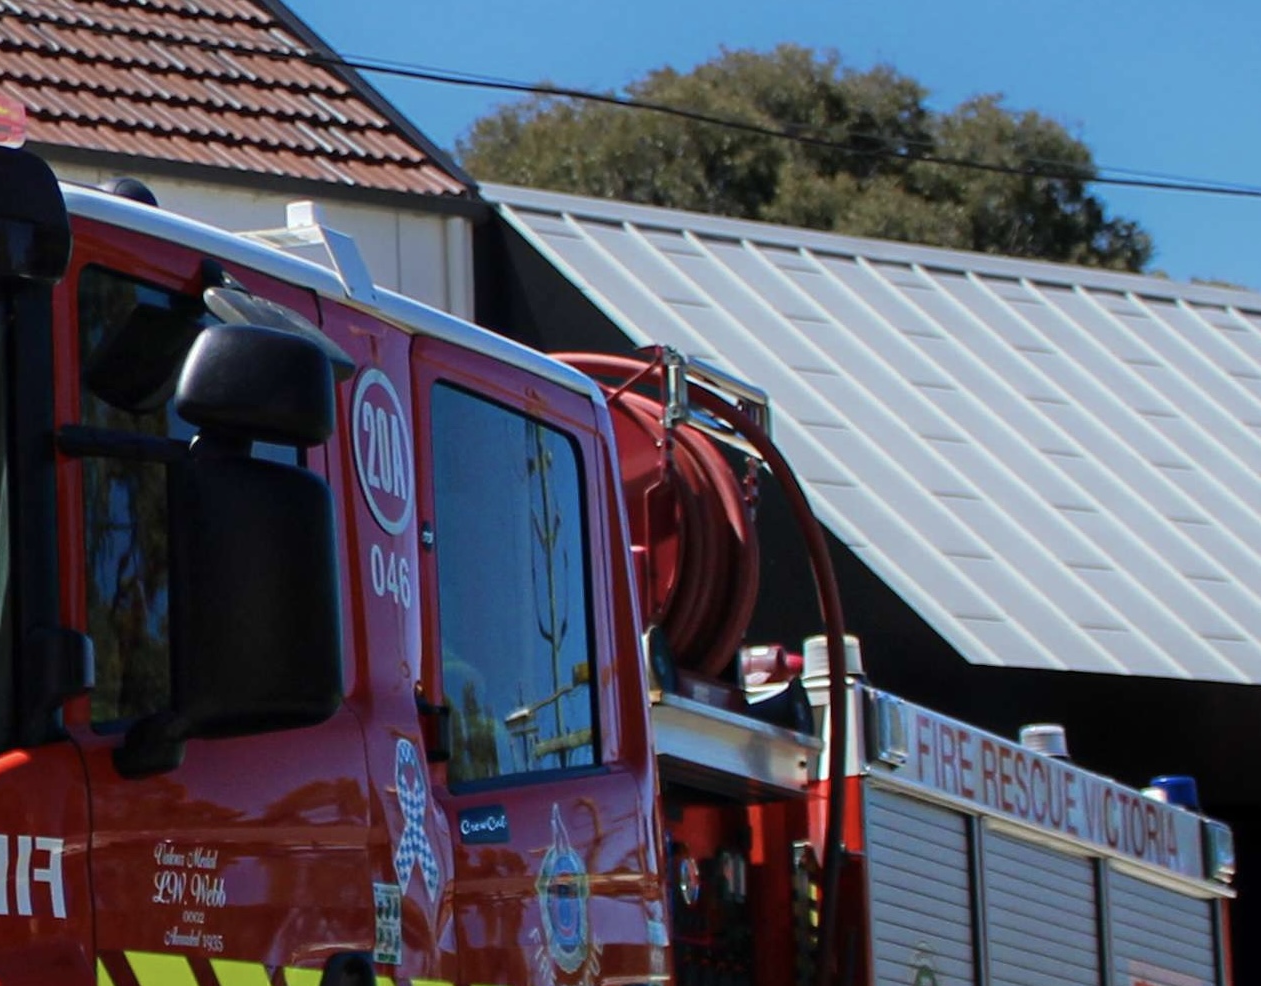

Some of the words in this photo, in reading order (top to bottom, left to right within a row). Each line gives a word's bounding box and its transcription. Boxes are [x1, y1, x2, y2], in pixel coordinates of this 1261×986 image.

[362, 401, 406, 500] 20A
[371, 544, 411, 608] 046
[916, 713, 974, 799] FIRE
[980, 739, 1079, 837] RESCUE
[1082, 776, 1178, 868] VICTORIA
[191, 873, 226, 908] Webb
